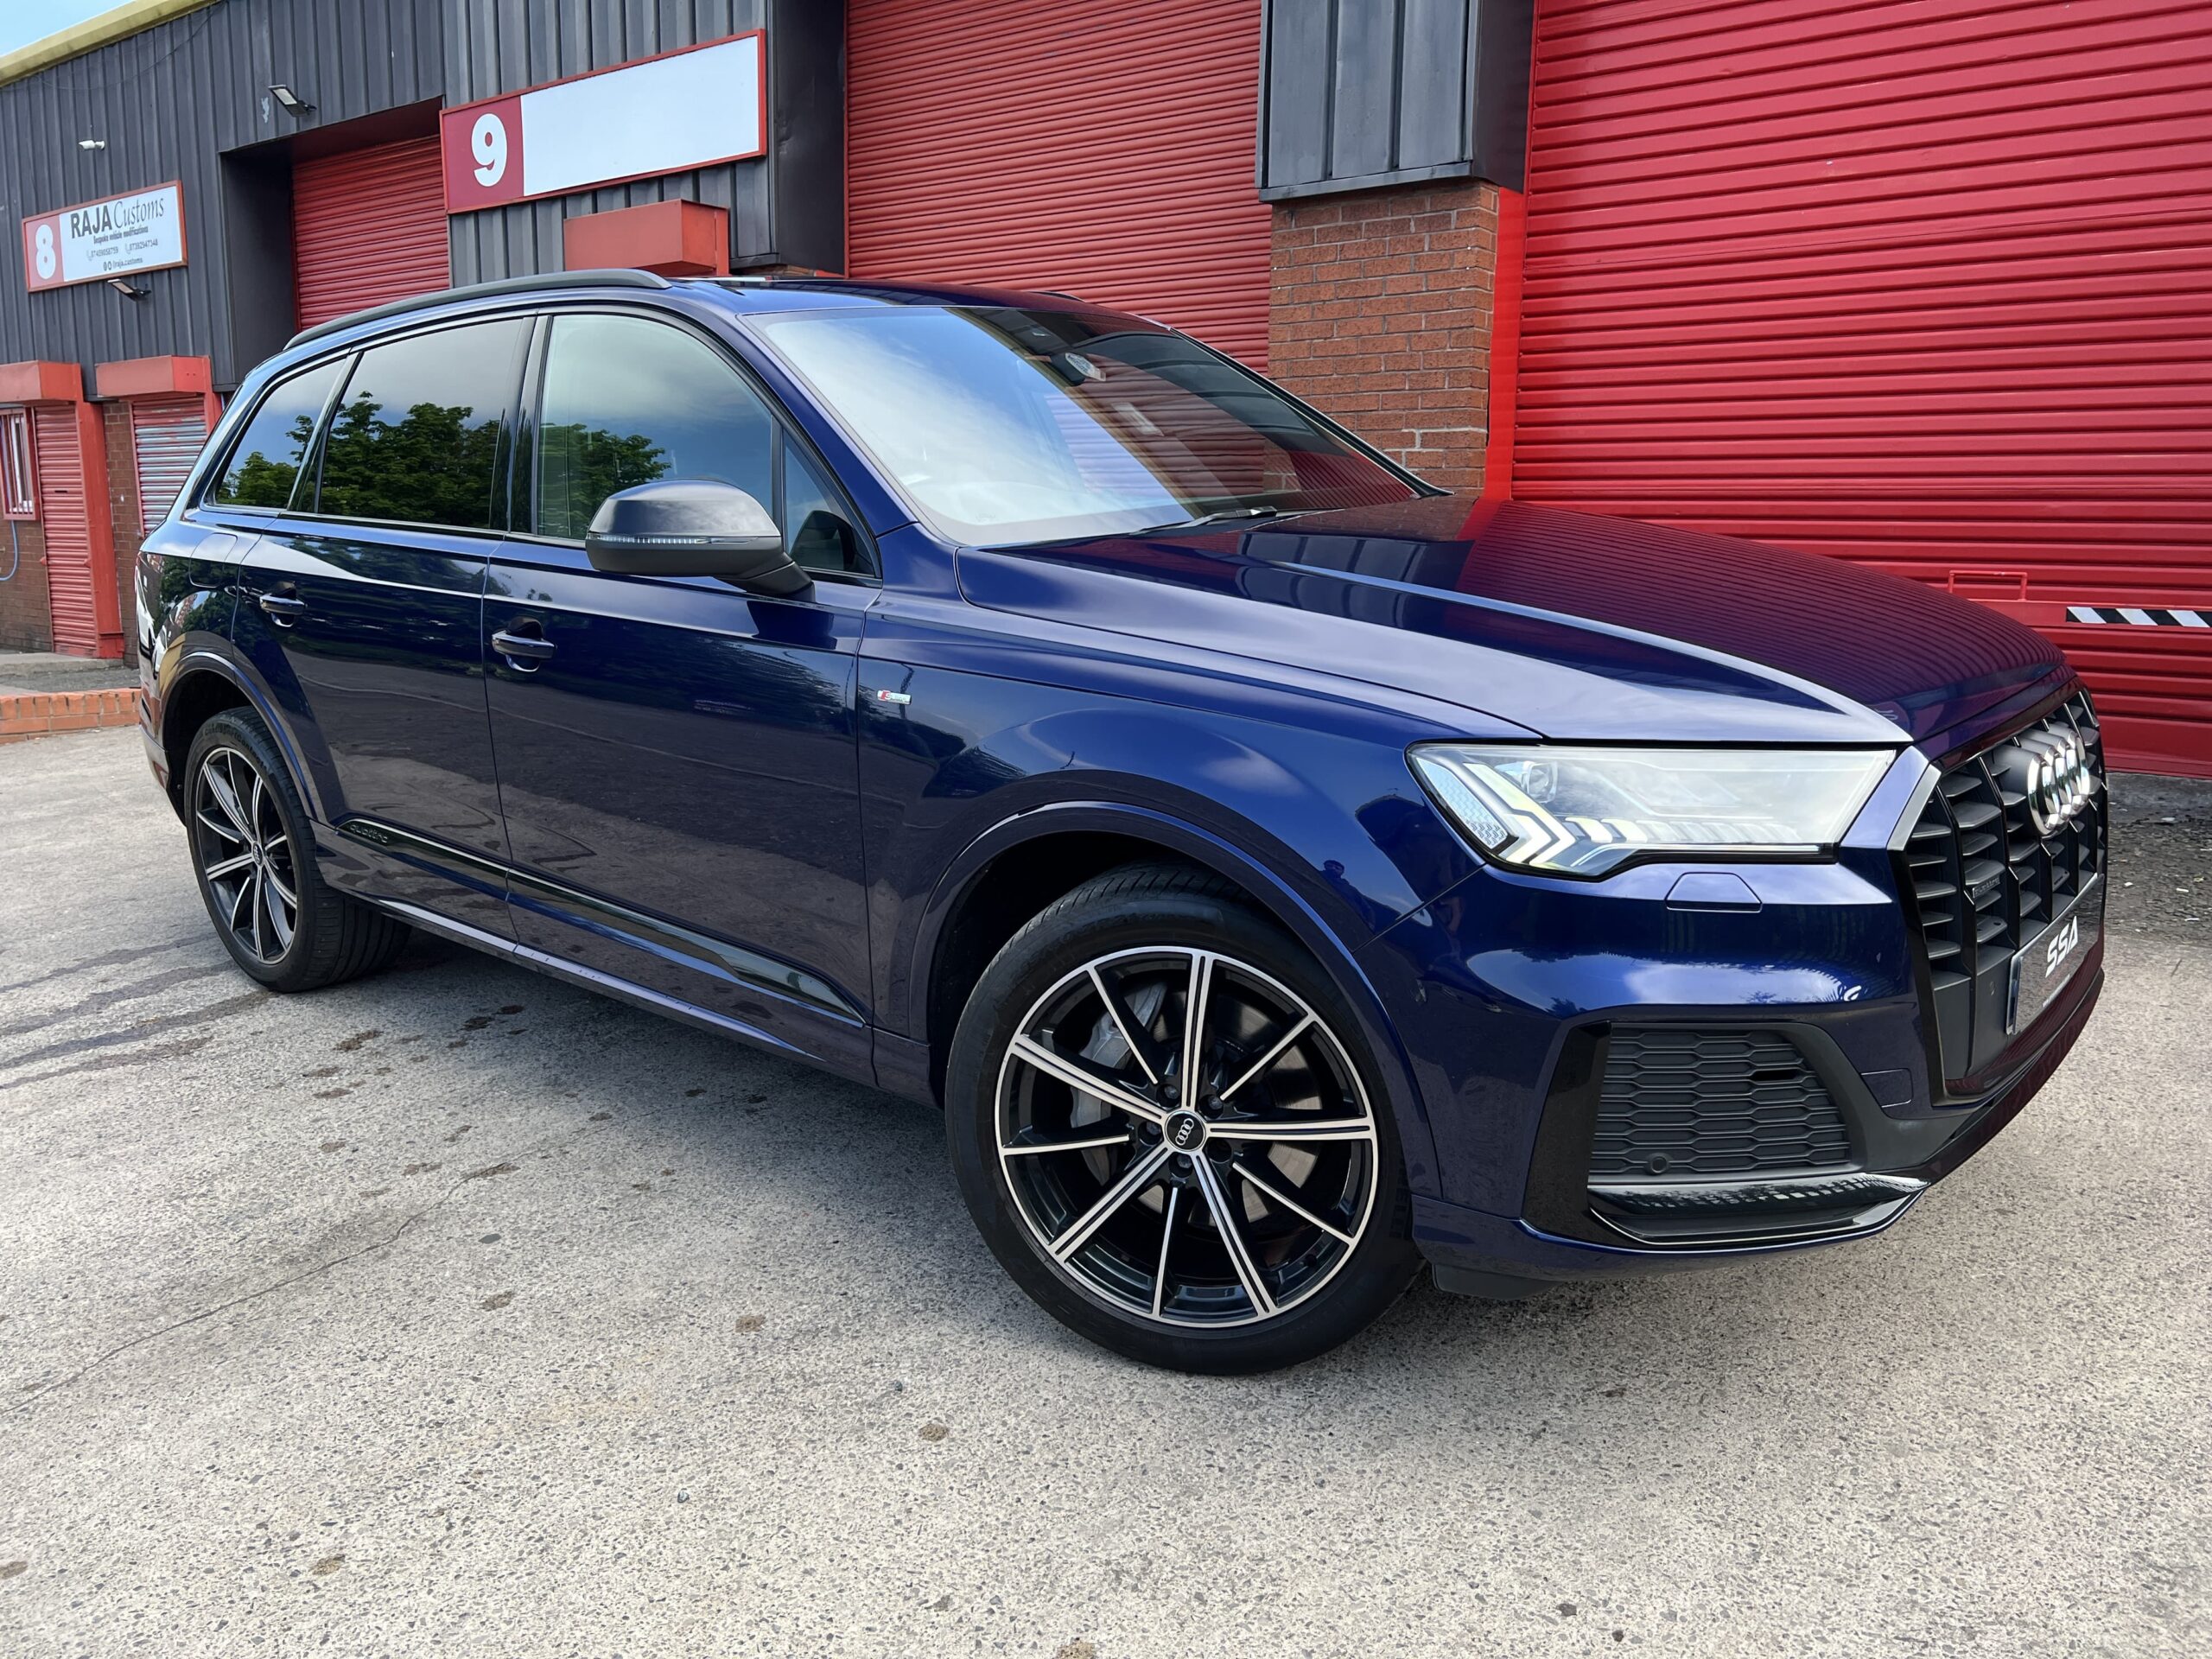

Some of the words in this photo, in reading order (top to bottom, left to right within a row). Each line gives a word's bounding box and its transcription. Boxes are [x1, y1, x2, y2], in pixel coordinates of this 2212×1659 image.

[471, 113, 508, 187] 9
[70, 205, 112, 238] RAJA
[113, 197, 164, 229] Customs
[35, 224, 56, 279] 8
[350, 824, 388, 843] quattro
[2044, 915, 2079, 979] SSA
